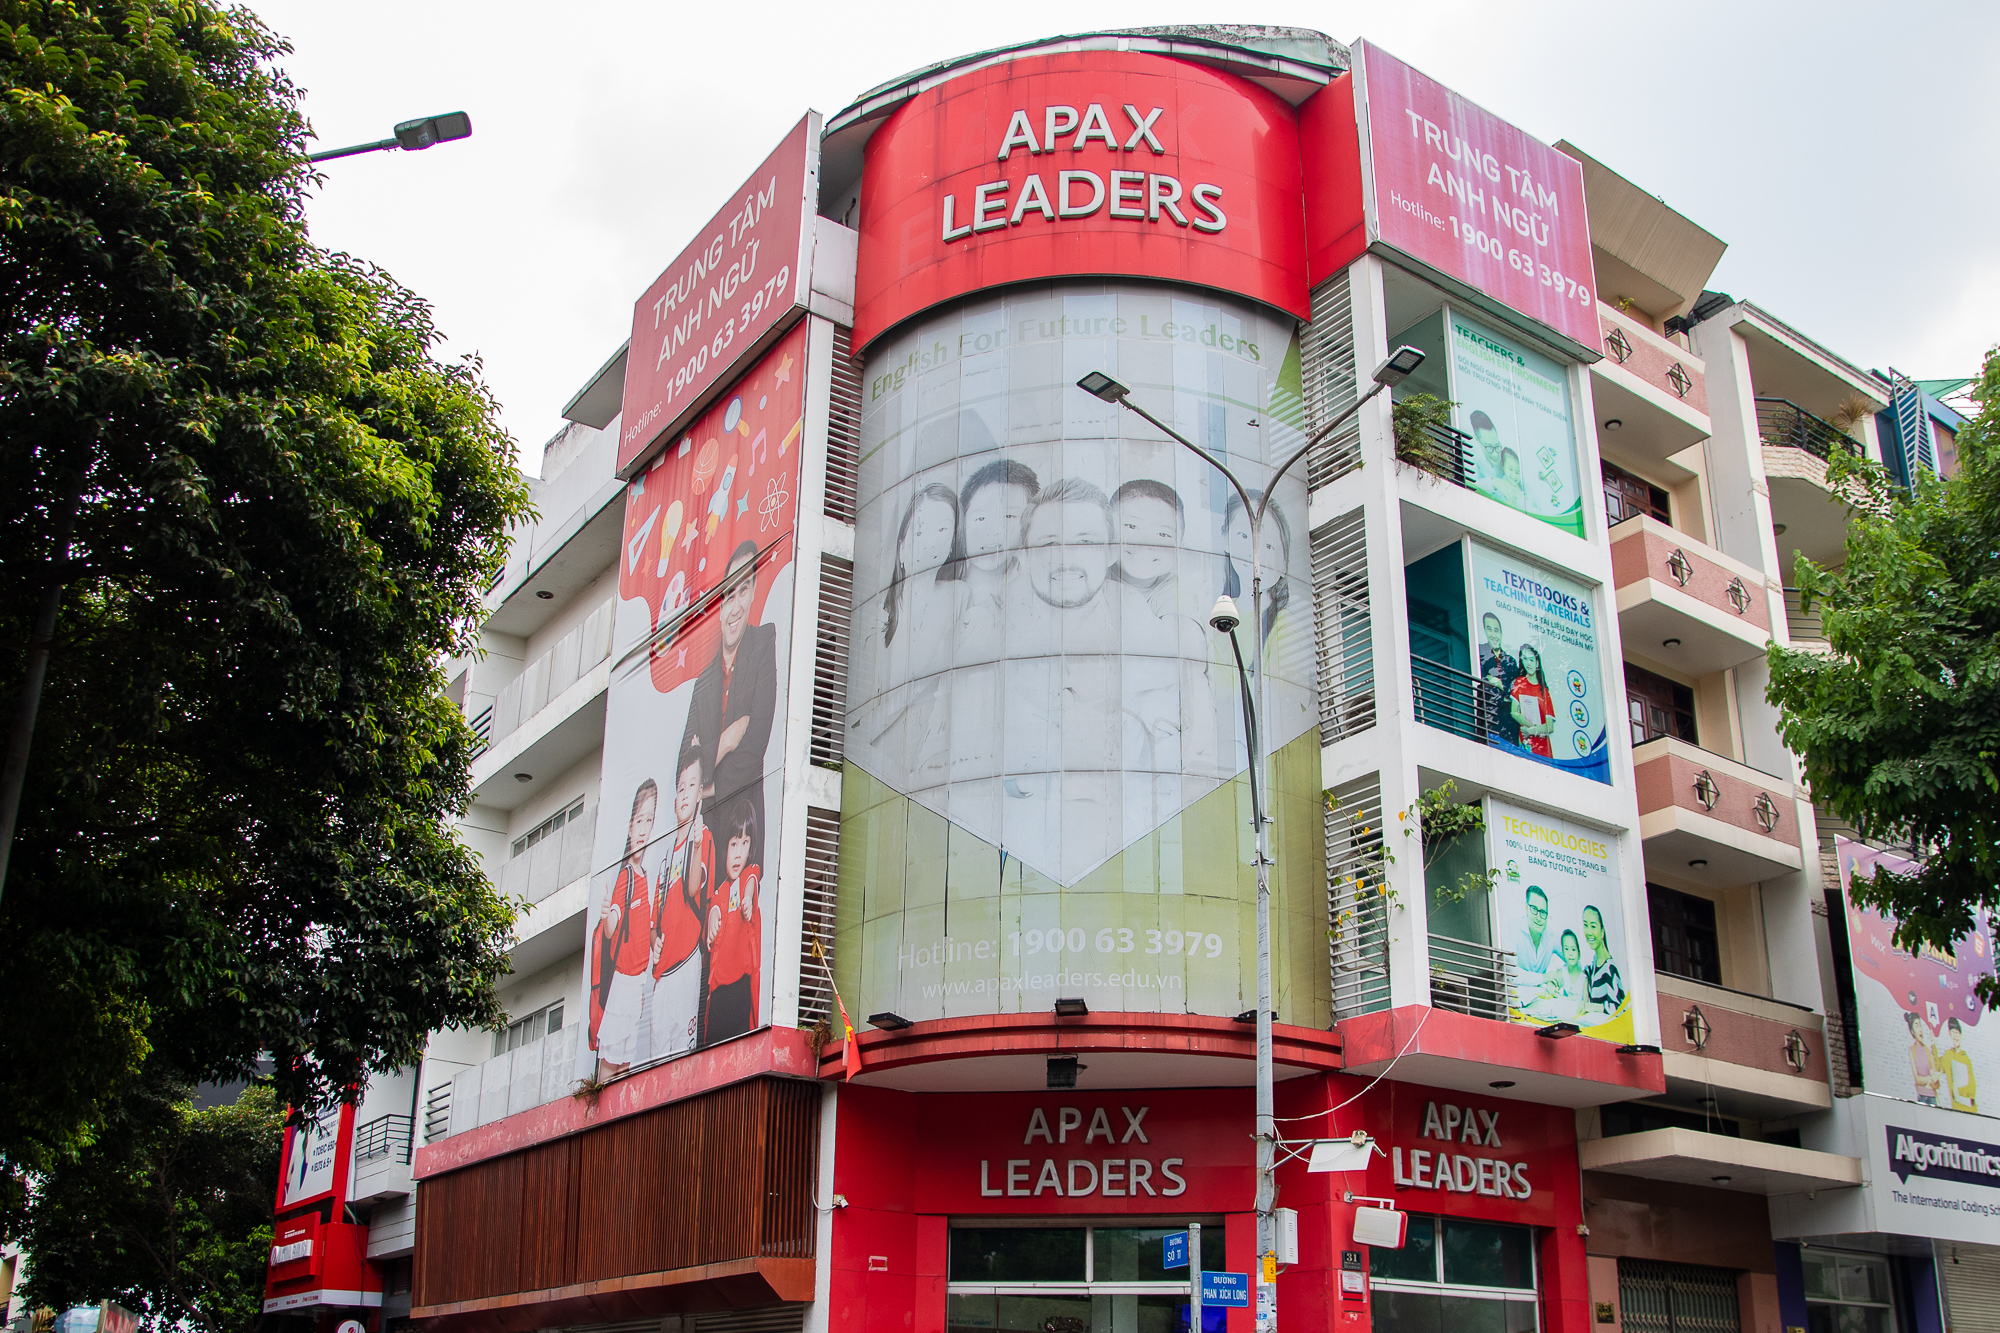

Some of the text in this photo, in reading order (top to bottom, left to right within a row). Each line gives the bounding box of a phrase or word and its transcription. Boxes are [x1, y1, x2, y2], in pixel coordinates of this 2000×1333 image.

[997, 102, 1165, 161] APAX
[1405, 108, 1559, 217] TRUNG TÂM
[942, 169, 1228, 243] LEADERS
[1427, 162, 1549, 247] ANH NGỮ
[653, 175, 776, 330] TRUNG TÂM
[1390, 189, 1591, 307] Hotline: 1900 63 3979
[656, 237, 760, 372] ANH NGỮ
[624, 265, 790, 447] Hotline: 1900 63 3979
[871, 313, 1261, 401] English For Future Leaders
[1455, 324, 1526, 368] TEACHERS &
[1456, 337, 1560, 396] ENGLISH ENVIRONMENT
[1483, 577, 1591, 629] TEACHING MATERIALS
[1495, 600, 1512, 611] GIÁO
[1502, 569, 1590, 616] TEXTBOOKS &
[1502, 815, 1607, 860] TECHNOLOGIES
[1506, 839, 1523, 851] 100%
[1524, 842, 1539, 853] LỚP
[1540, 847, 1555, 860] HỌC
[1555, 852, 1577, 865] ĐƯỢC
[1578, 858, 1600, 871] TRANG
[1549, 861, 1574, 875] TƯƠNG
[1574, 866, 1588, 878] TÁC
[897, 927, 1223, 970] Hotline: 1900 63 3979
[922, 967, 1183, 999] www.apaxleaders.edu.vn
[1023, 1106, 1150, 1145] APAX
[1420, 1101, 1502, 1148] APAX
[980, 1157, 1187, 1198] LEADERS
[1392, 1146, 1532, 1200] LEADERS
[1895, 1133, 2000, 1177] Algorithmics
[1892, 1190, 1908, 1203] The
[1909, 1192, 1960, 1210] International
[1960, 1199, 1988, 1217] Coding
[1167, 1247, 1175, 1262] SỐ
[1346, 1252, 1358, 1263] 31
[1203, 1288, 1217, 1299] PHAN
[1219, 1286, 1232, 1300] XÍCH
[1233, 1289, 1247, 1300] LONG
[1213, 1274, 1237, 1285] ĐƯỜNG
